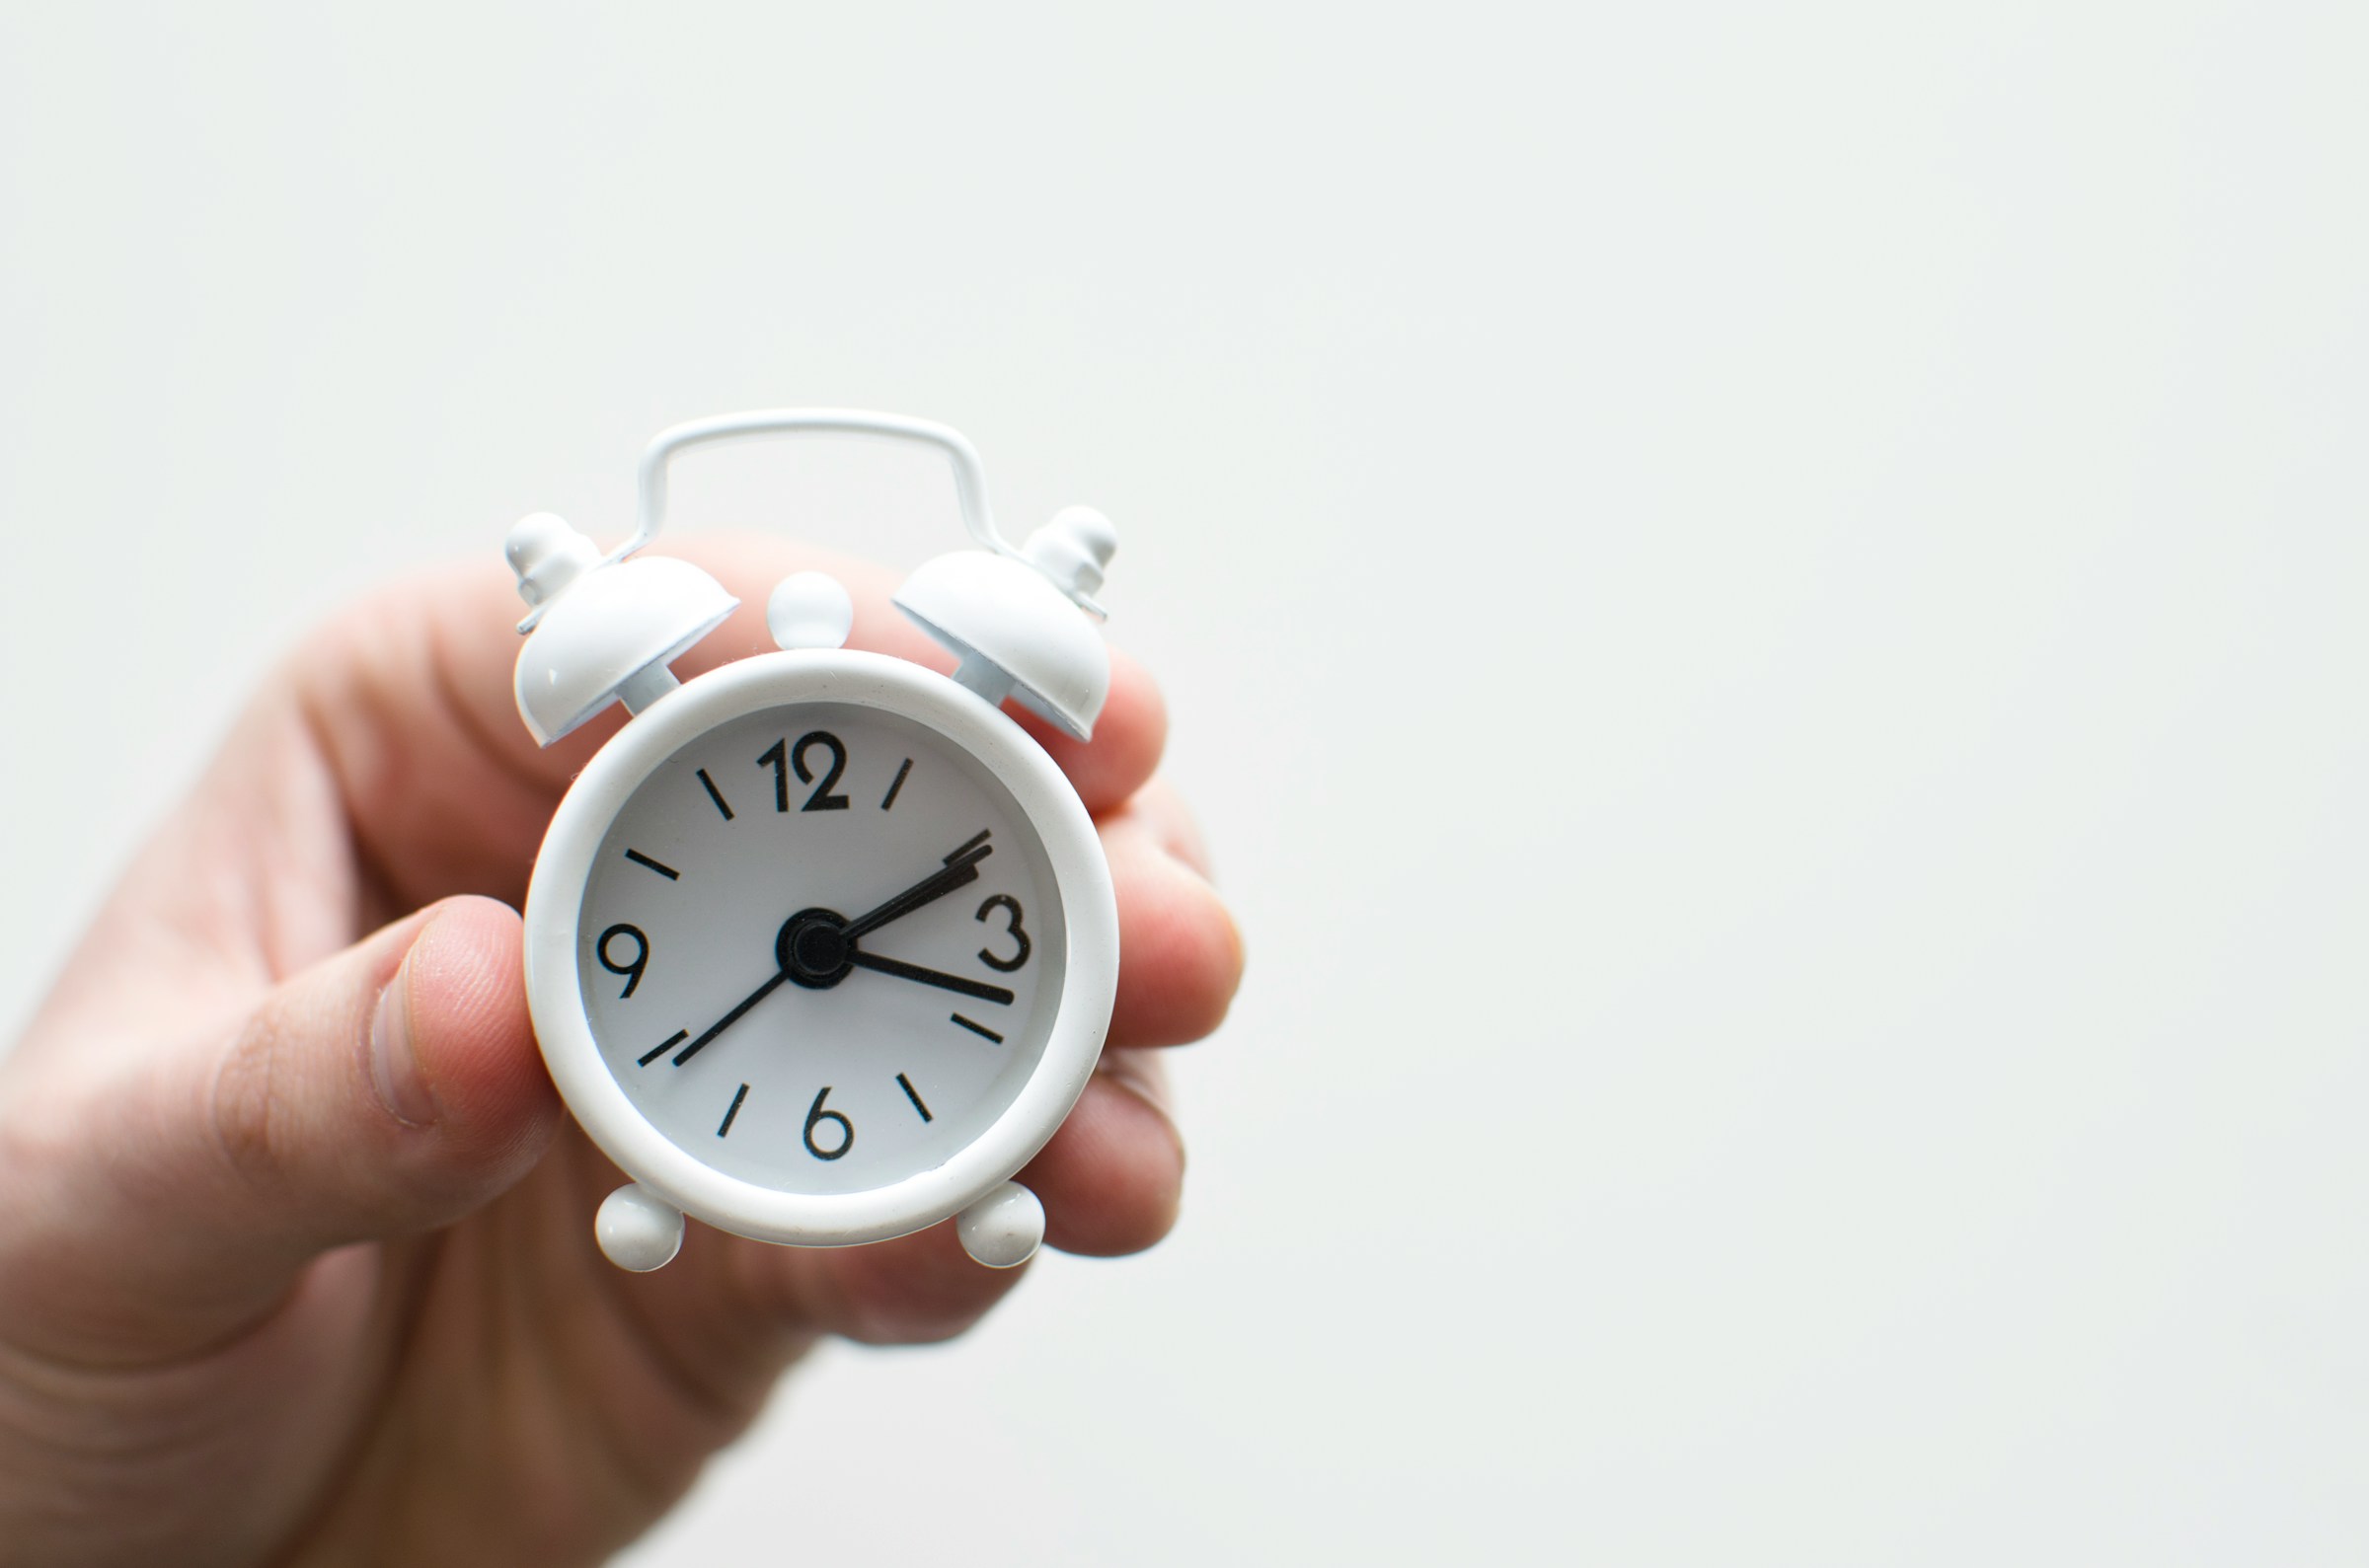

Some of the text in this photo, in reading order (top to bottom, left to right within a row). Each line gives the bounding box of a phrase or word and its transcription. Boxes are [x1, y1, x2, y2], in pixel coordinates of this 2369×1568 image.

[756, 730, 850, 813] 12
[596, 923, 650, 1000] 9
[974, 893, 1032, 973] 3
[803, 1086, 855, 1161] 6
